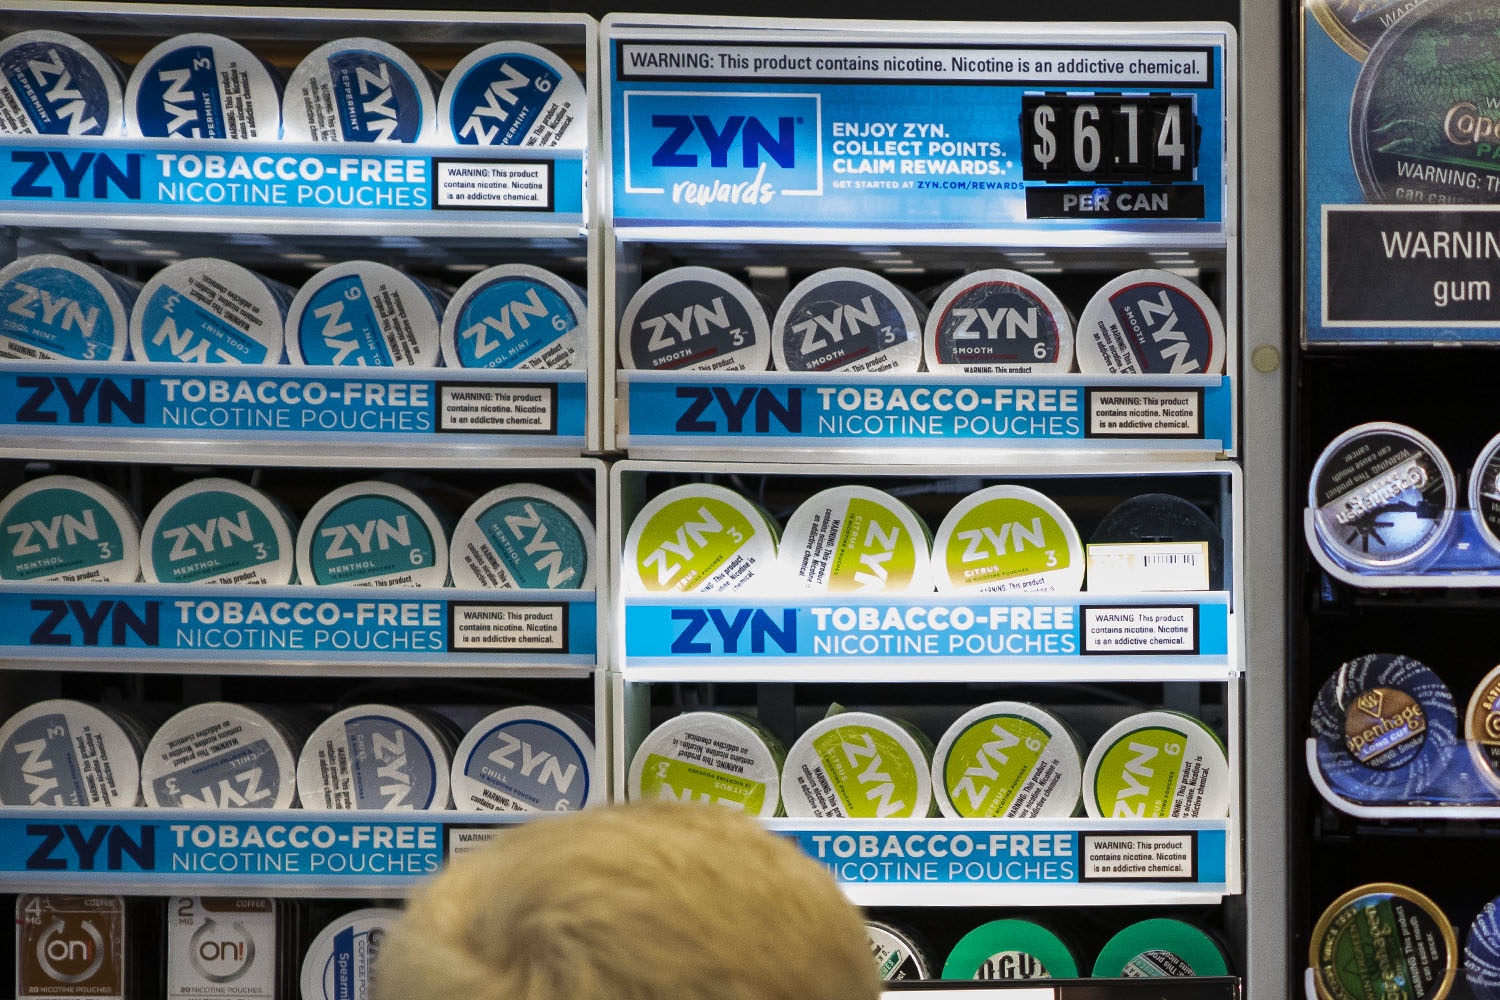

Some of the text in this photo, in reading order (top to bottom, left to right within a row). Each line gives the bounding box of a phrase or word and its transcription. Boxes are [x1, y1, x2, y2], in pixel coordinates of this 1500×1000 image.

[630, 52, 1200, 74] WARNING: This product contains nicotine. Nicotine is an addictive chemical.
[833, 122, 949, 138] ENJOY ZYN.
[652, 115, 796, 168] ZYN
[832, 141, 1006, 156] COLLECT POINTS.
[11, 151, 142, 200] ZYN
[157, 154, 426, 183] TOBACCO-FREE
[832, 159, 895, 174] CLAIM
[158, 183, 427, 207] NICOTINE POUCHES
[672, 162, 776, 206] rewards
[833, 181, 1024, 190] GET STARTED AT ZYN.COM/REWARDS
[1063, 193, 1168, 211] PER CAN
[1433, 281, 1491, 307] gum
[953, 306, 1038, 340] ZYN
[1032, 342, 1047, 358] 6
[675, 387, 801, 433] ZYN
[817, 388, 1078, 412] TOBACCO-FREE
[1100, 397, 1189, 407] WARNING: This product
[1096, 409, 1193, 417] contains nicotine. Nicotine
[1100, 420, 1106, 428] is
[1119, 420, 1152, 428] addictive
[1154, 420, 1189, 428] chemical.
[818, 415, 1079, 437] NICOTINE POUCHES
[321, 514, 412, 560] ZYN
[958, 517, 1046, 564] ZYN
[30, 601, 161, 646] ZYN
[175, 601, 441, 626] TOBACCO-FREE
[812, 607, 1073, 631] TOBACCO-FREE
[176, 629, 443, 650] NICOTINE POUCHES
[671, 608, 798, 653] ZYN
[814, 634, 1076, 655] NICOTINE POUCHES
[812, 834, 1072, 857] TOBACCO-FREE
[949, 862, 1073, 880] POUCHES
[47, 940, 93, 962] on!
[199, 941, 244, 962] on!
